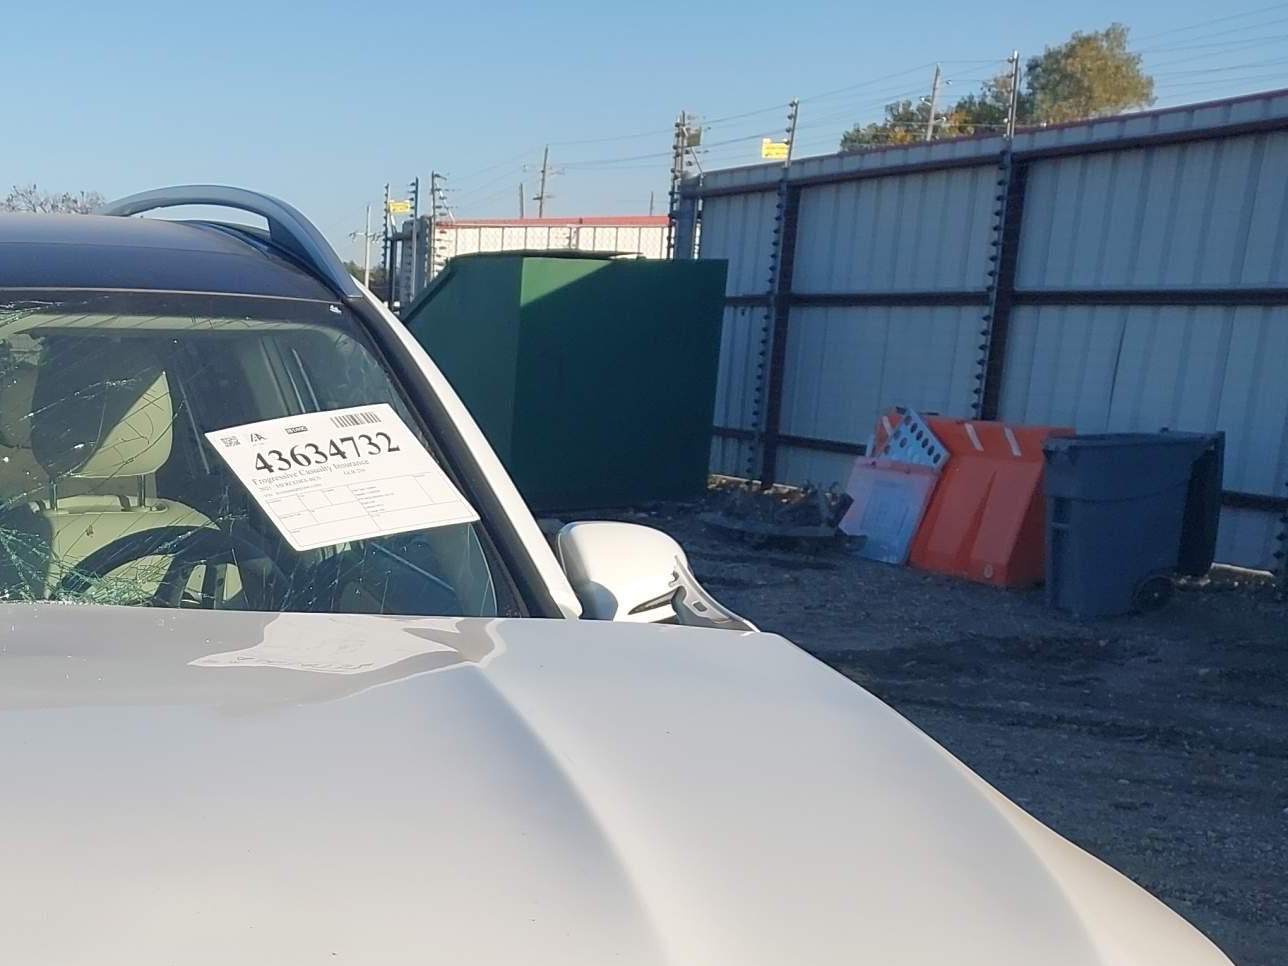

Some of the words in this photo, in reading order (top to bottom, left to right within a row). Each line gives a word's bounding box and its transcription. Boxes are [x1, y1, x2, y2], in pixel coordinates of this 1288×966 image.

[255, 432, 401, 473] 43634732
[252, 471, 298, 486] Progressive
[298, 464, 333, 477] Casualty
[333, 459, 370, 470] Insurance
